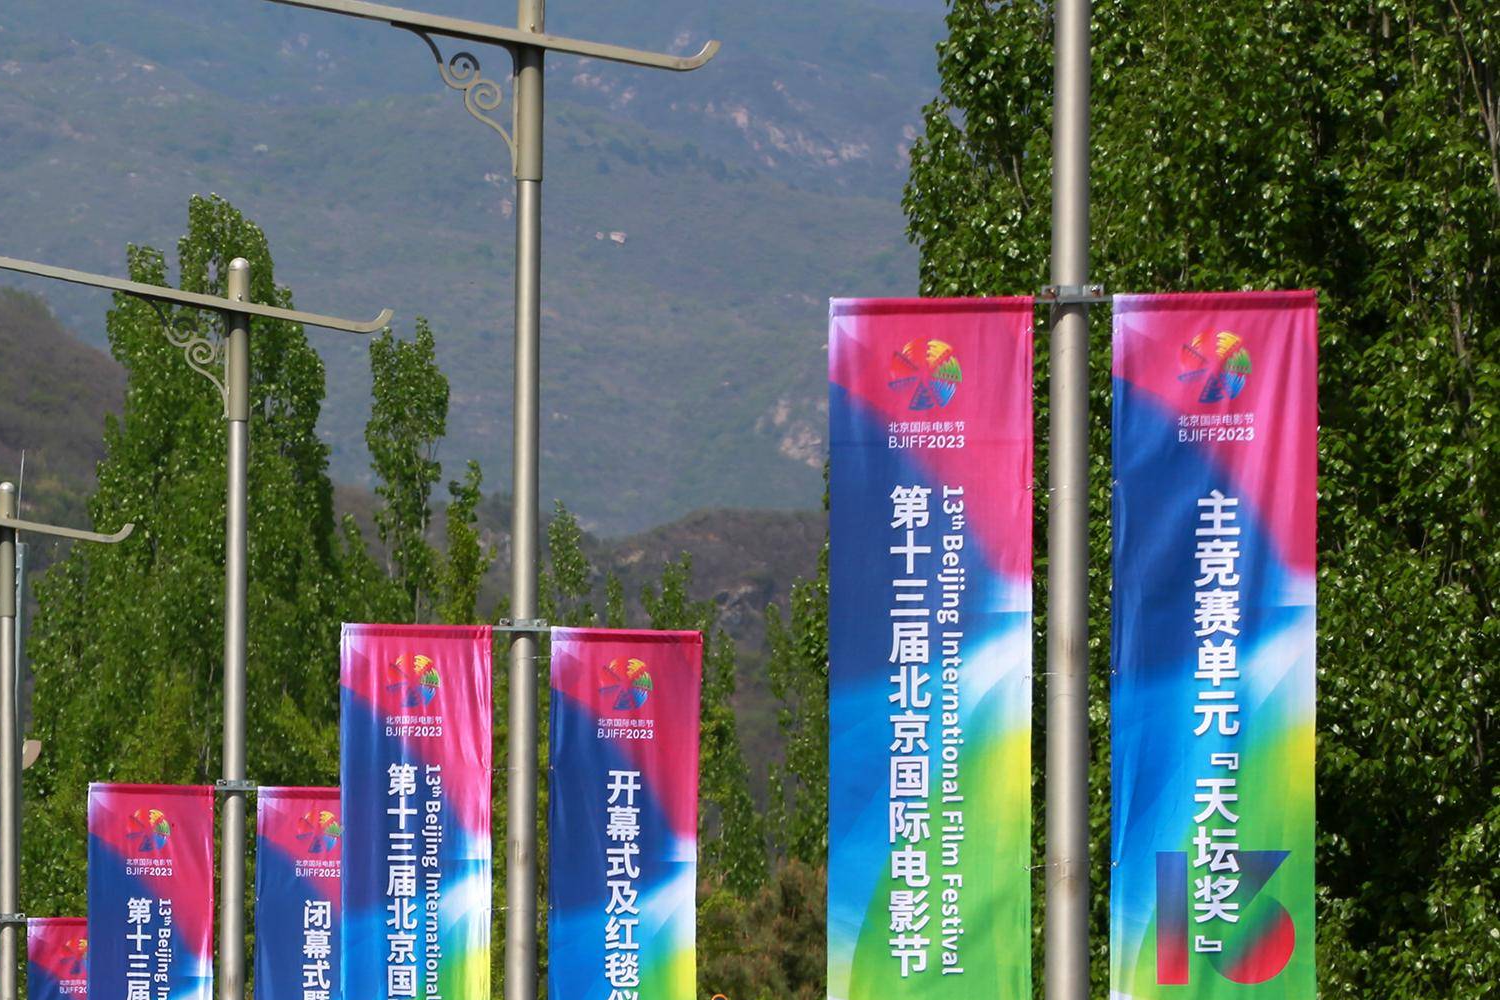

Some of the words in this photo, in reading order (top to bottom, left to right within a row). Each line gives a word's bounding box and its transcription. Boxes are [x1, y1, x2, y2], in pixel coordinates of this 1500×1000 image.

[888, 422, 965, 434] 北京国际电影节
[1178, 414, 1254, 426] 北京国际电影节
[1178, 427, 1255, 442] BJIFF2023
[888, 435, 965, 449] BJIFF2023
[941, 485, 965, 531] 13th
[937, 535, 965, 625] Beijing
[385, 726, 443, 737] BJIFF2023
[386, 715, 443, 726] 北京国际电影节
[598, 718, 654, 728] 北京国际电影节
[888, 485, 932, 978] 第十三届北京国际电影节
[941, 631, 965, 803] International
[1193, 490, 1241, 955] 主竞赛单元『天坛奖』
[597, 728, 654, 740] BJIFF2023
[426, 764, 442, 799] 13th
[421, 801, 442, 867] Beijing
[941, 810, 965, 867] Film
[126, 867, 173, 877] BJIFF2023
[157, 898, 172, 927] 13th
[941, 873, 965, 976] Festival
[154, 928, 172, 983] Beijing
